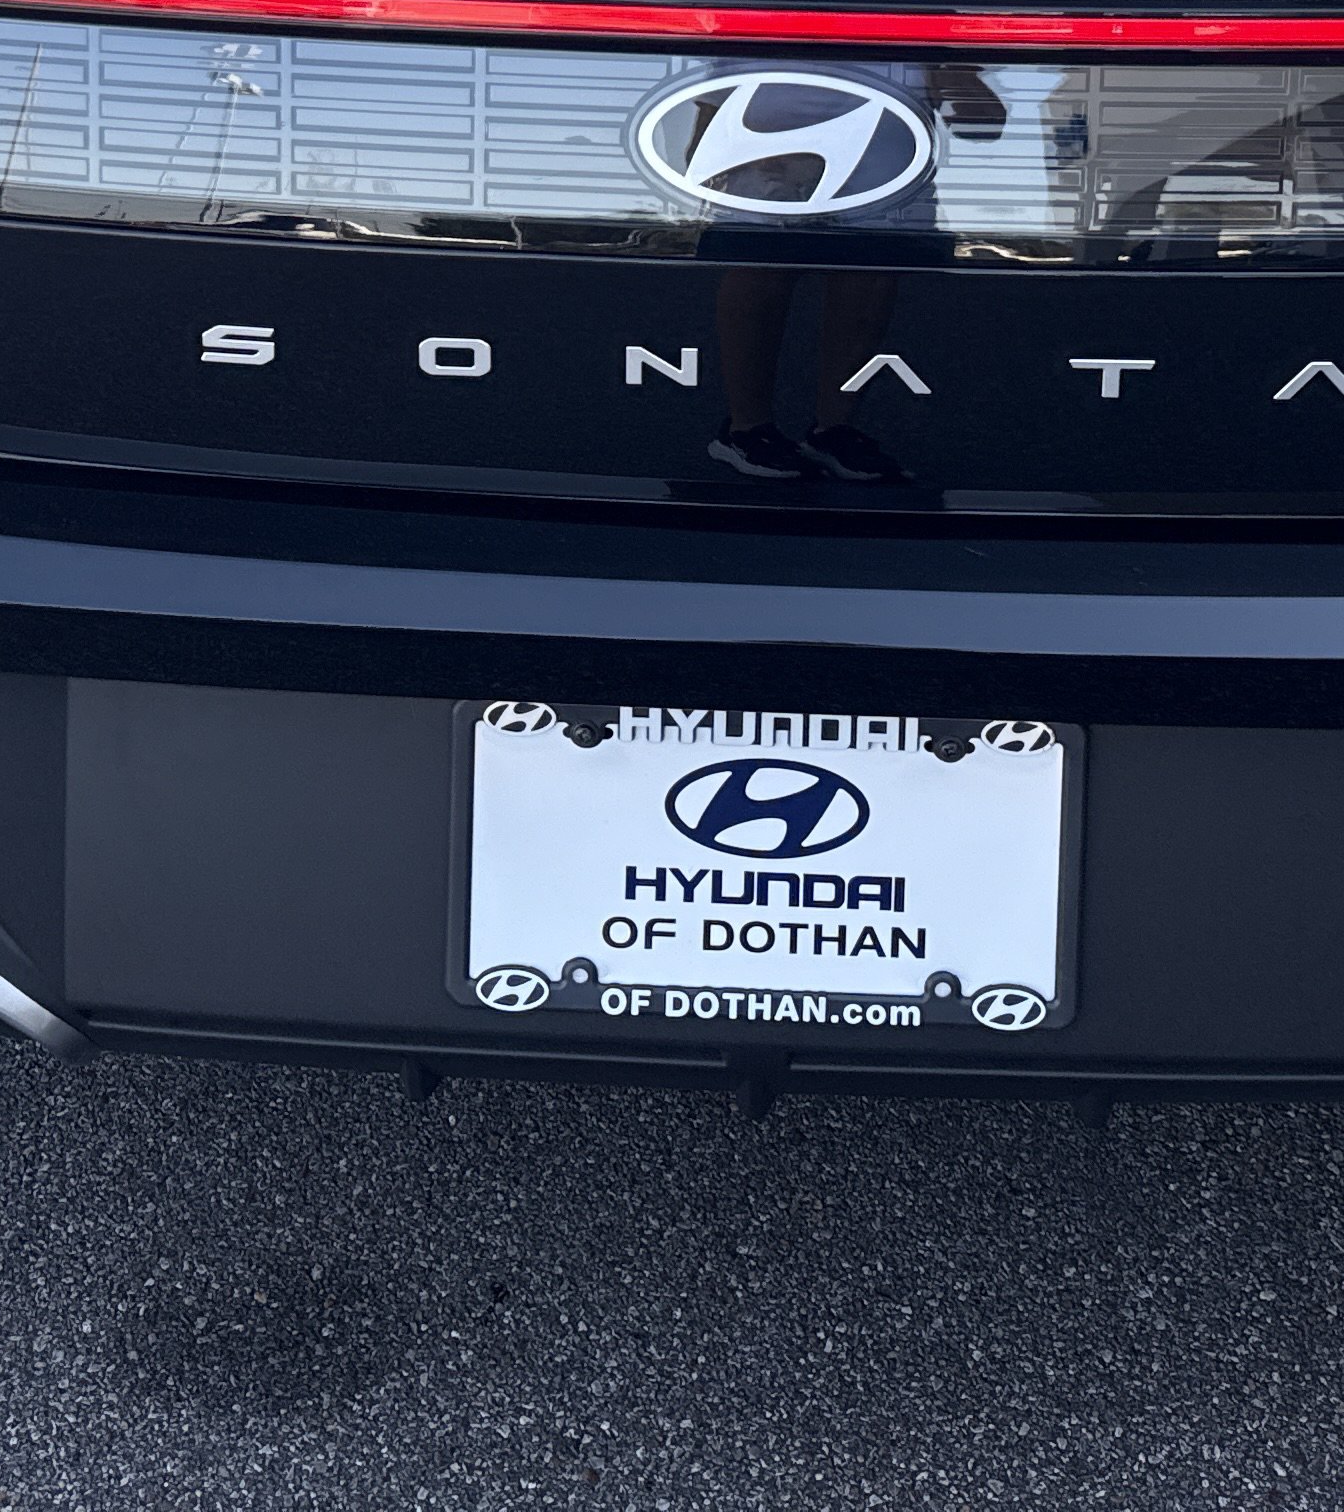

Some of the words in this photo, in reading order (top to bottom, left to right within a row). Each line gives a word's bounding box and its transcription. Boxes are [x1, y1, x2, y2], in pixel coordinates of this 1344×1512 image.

[617, 706, 919, 753] HYUNDAI
[624, 865, 906, 913] HYUNDAI
[602, 916, 677, 950] OF
[702, 919, 927, 959] DOTHAN
[600, 987, 652, 1016] OF
[664, 989, 922, 1027] DOTHAN.com
